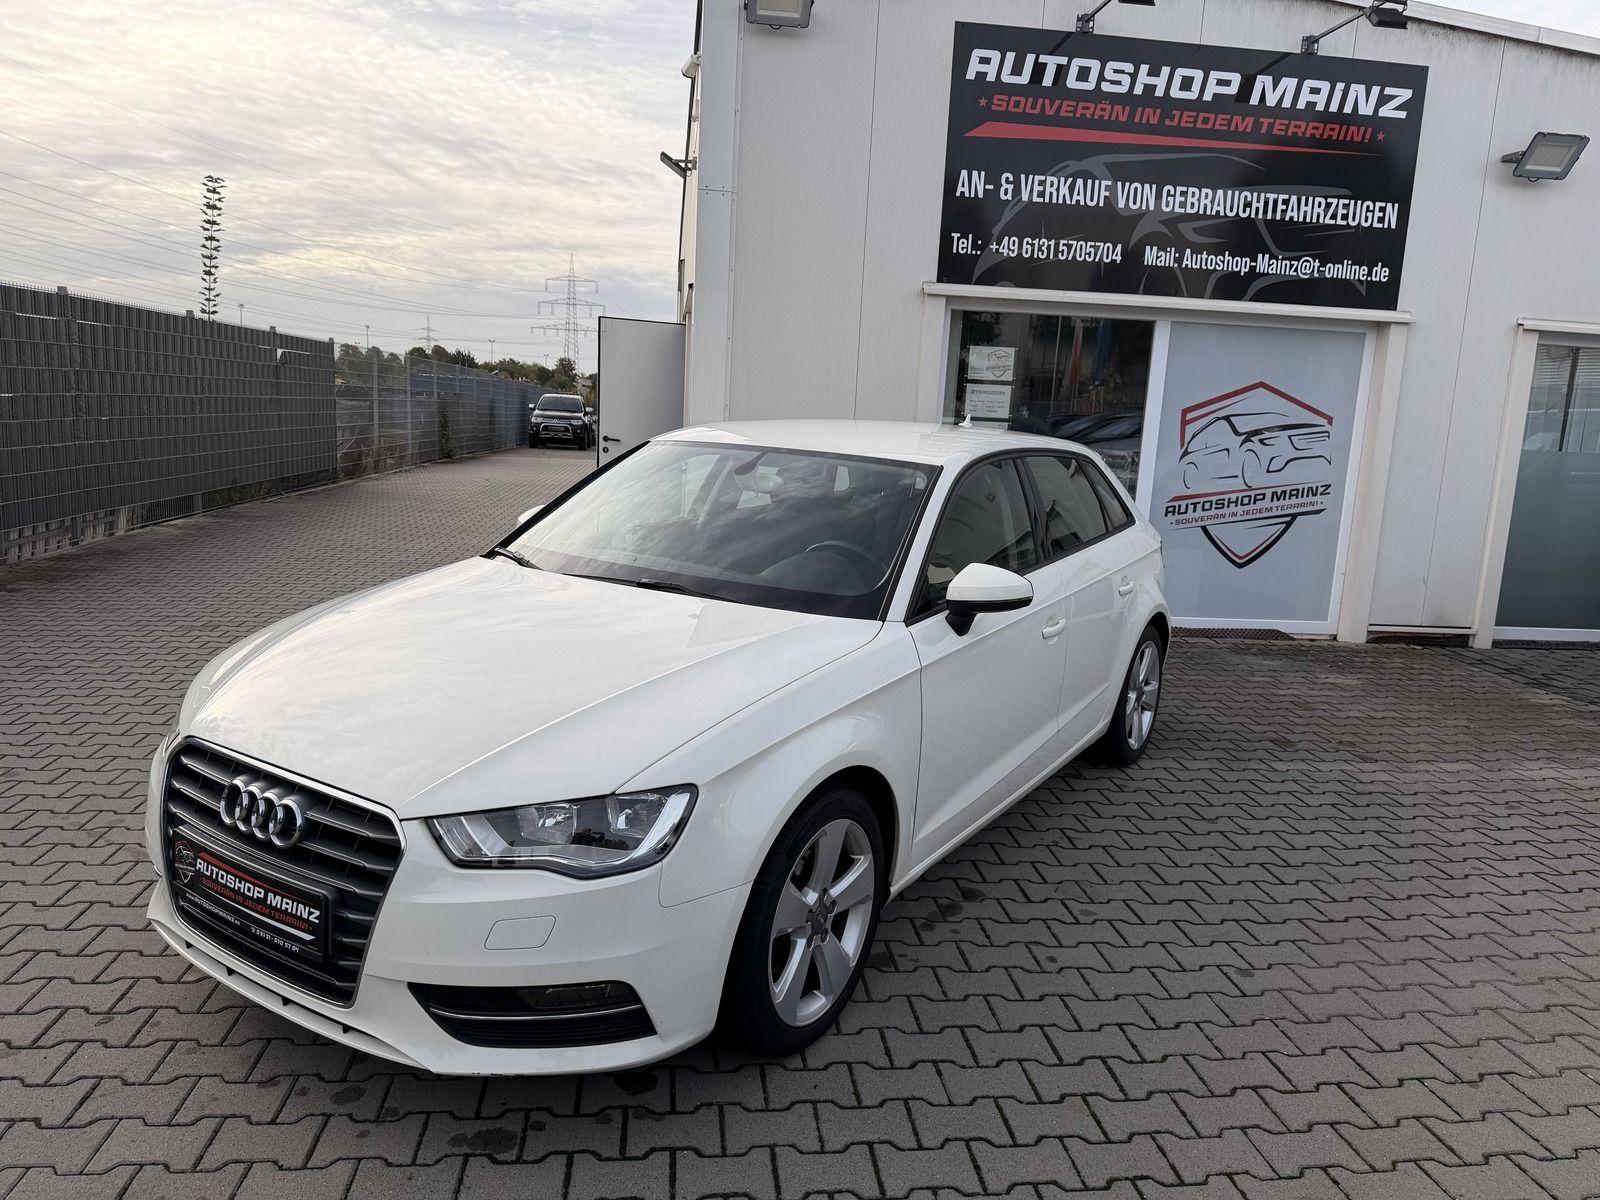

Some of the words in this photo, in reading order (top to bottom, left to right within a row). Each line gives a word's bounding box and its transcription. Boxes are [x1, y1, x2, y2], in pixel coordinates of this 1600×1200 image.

[965, 48, 1241, 102] AUTOSHOP
[1248, 74, 1413, 119] MAINZ
[991, 94, 1130, 122] SOUVERÄN
[1134, 107, 1161, 125] IN
[1165, 110, 1254, 133] JEDEM
[1259, 118, 1372, 143] TERRAIN!
[955, 169, 994, 198] AN-
[999, 172, 1014, 201] &
[1020, 174, 1112, 207] VERKAUF
[1117, 181, 1157, 211] VON
[1161, 184, 1399, 229] GEBRAUCHTFAHRZEUGEN
[951, 232, 982, 255] Tel.:
[989, 236, 1019, 258] +49
[1022, 237, 1054, 260] 6131
[1058, 240, 1122, 264] 5705704
[1144, 245, 1179, 268] Mail:
[1182, 248, 1390, 283] Autoshop-Mainz@t-online.de
[1164, 492, 1266, 518] AUTOSHOP
[1270, 484, 1332, 502] MAINZ
[1228, 511, 1238, 519] IN
[1239, 507, 1274, 517] JEDEM
[196, 858, 265, 899] AUTOSHOP
[267, 892, 320, 923] MAINZ
